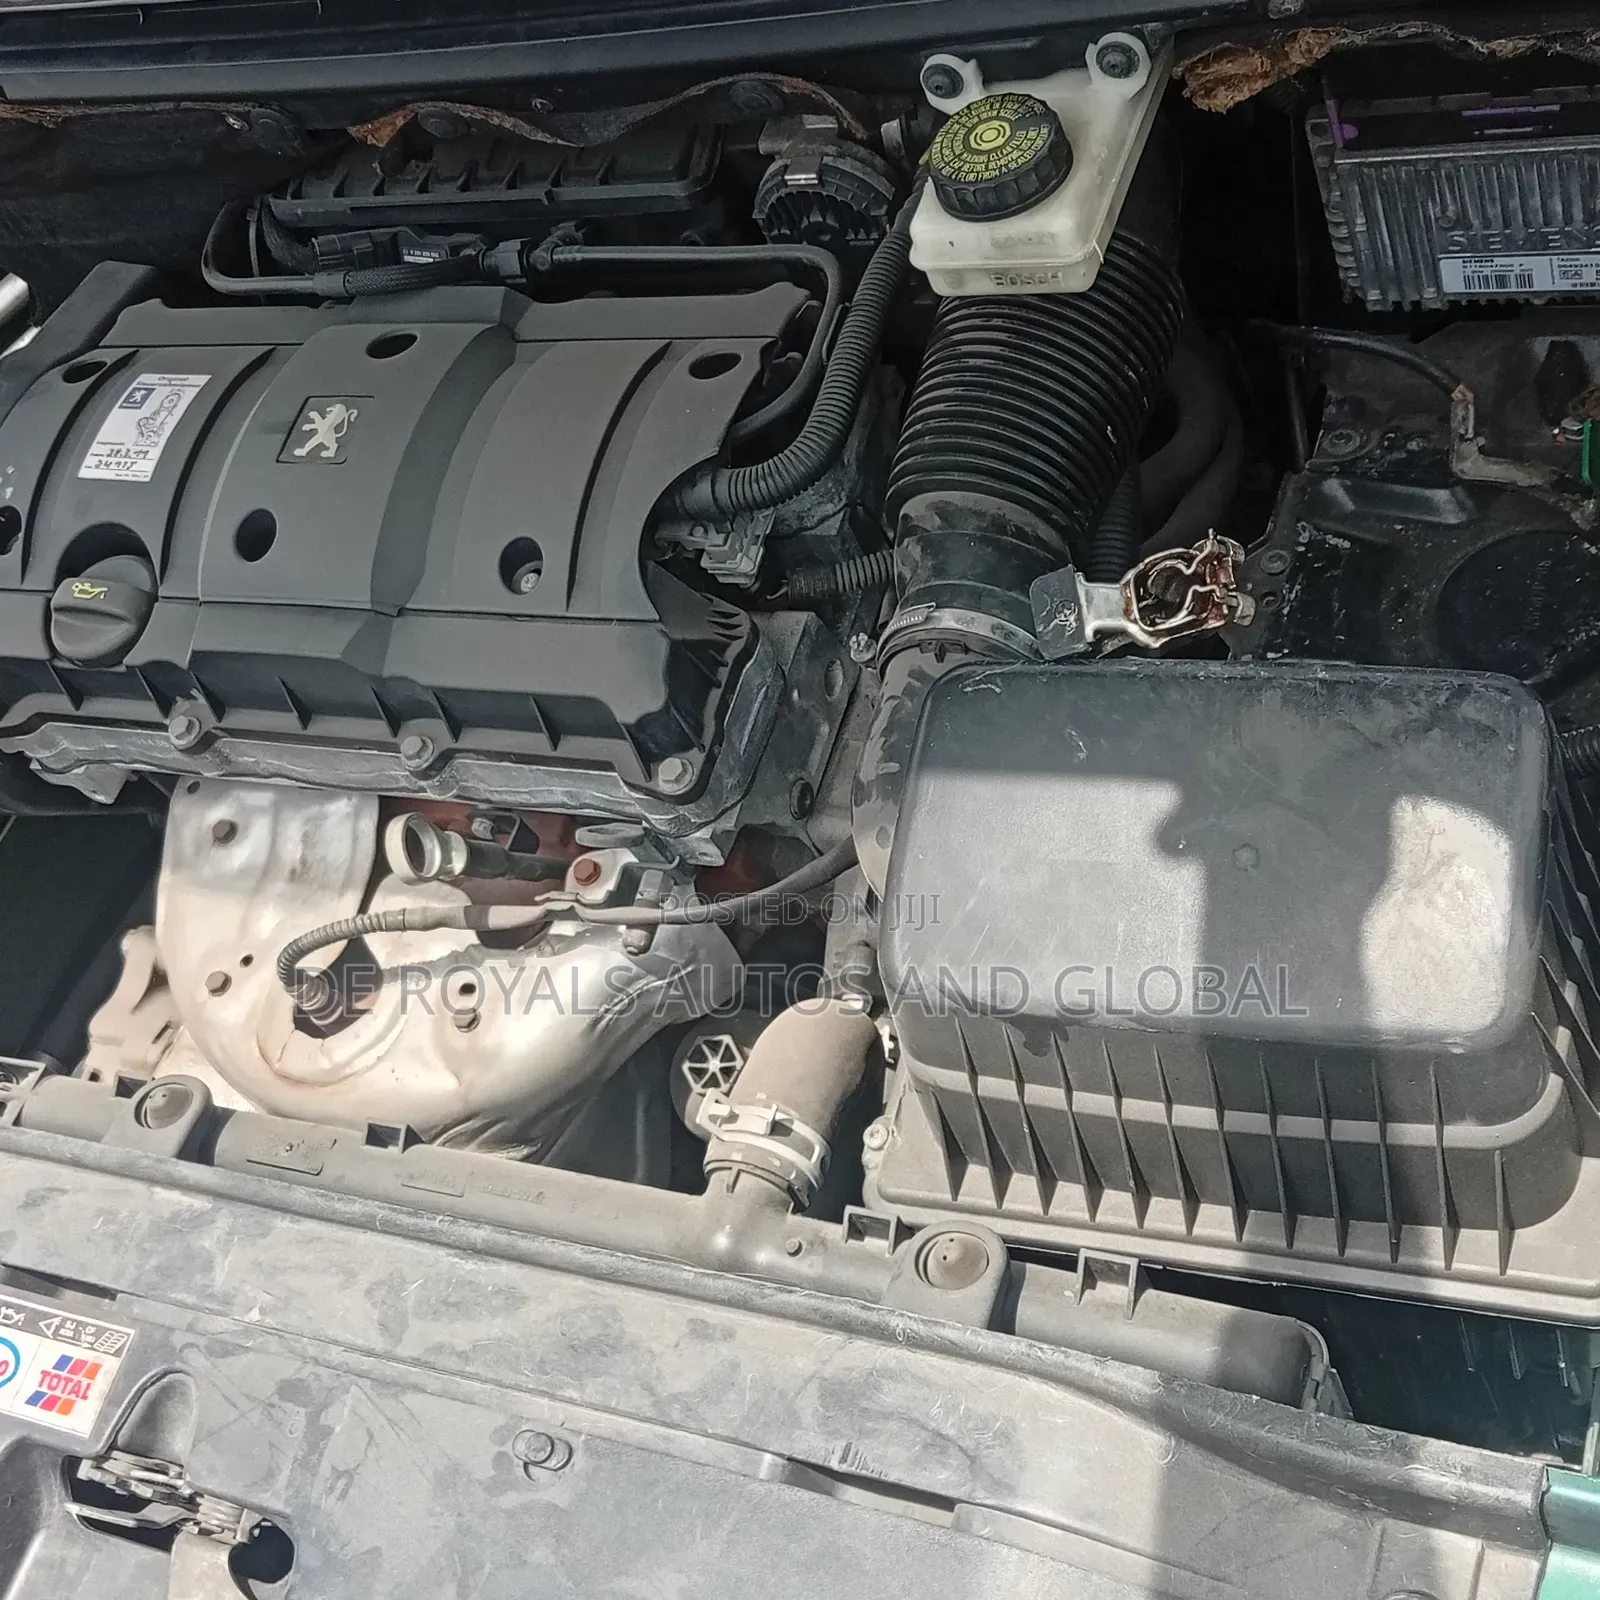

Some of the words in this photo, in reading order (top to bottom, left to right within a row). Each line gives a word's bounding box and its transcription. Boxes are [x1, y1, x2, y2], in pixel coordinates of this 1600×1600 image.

[978, 169, 1000, 181] FROM
[1001, 166, 1008, 174] A
[1007, 149, 1035, 170] SEALED
[989, 145, 1015, 161] CLEAN
[990, 272, 1064, 288] BOSCH
[38, 1369, 92, 1401] TOTAL
